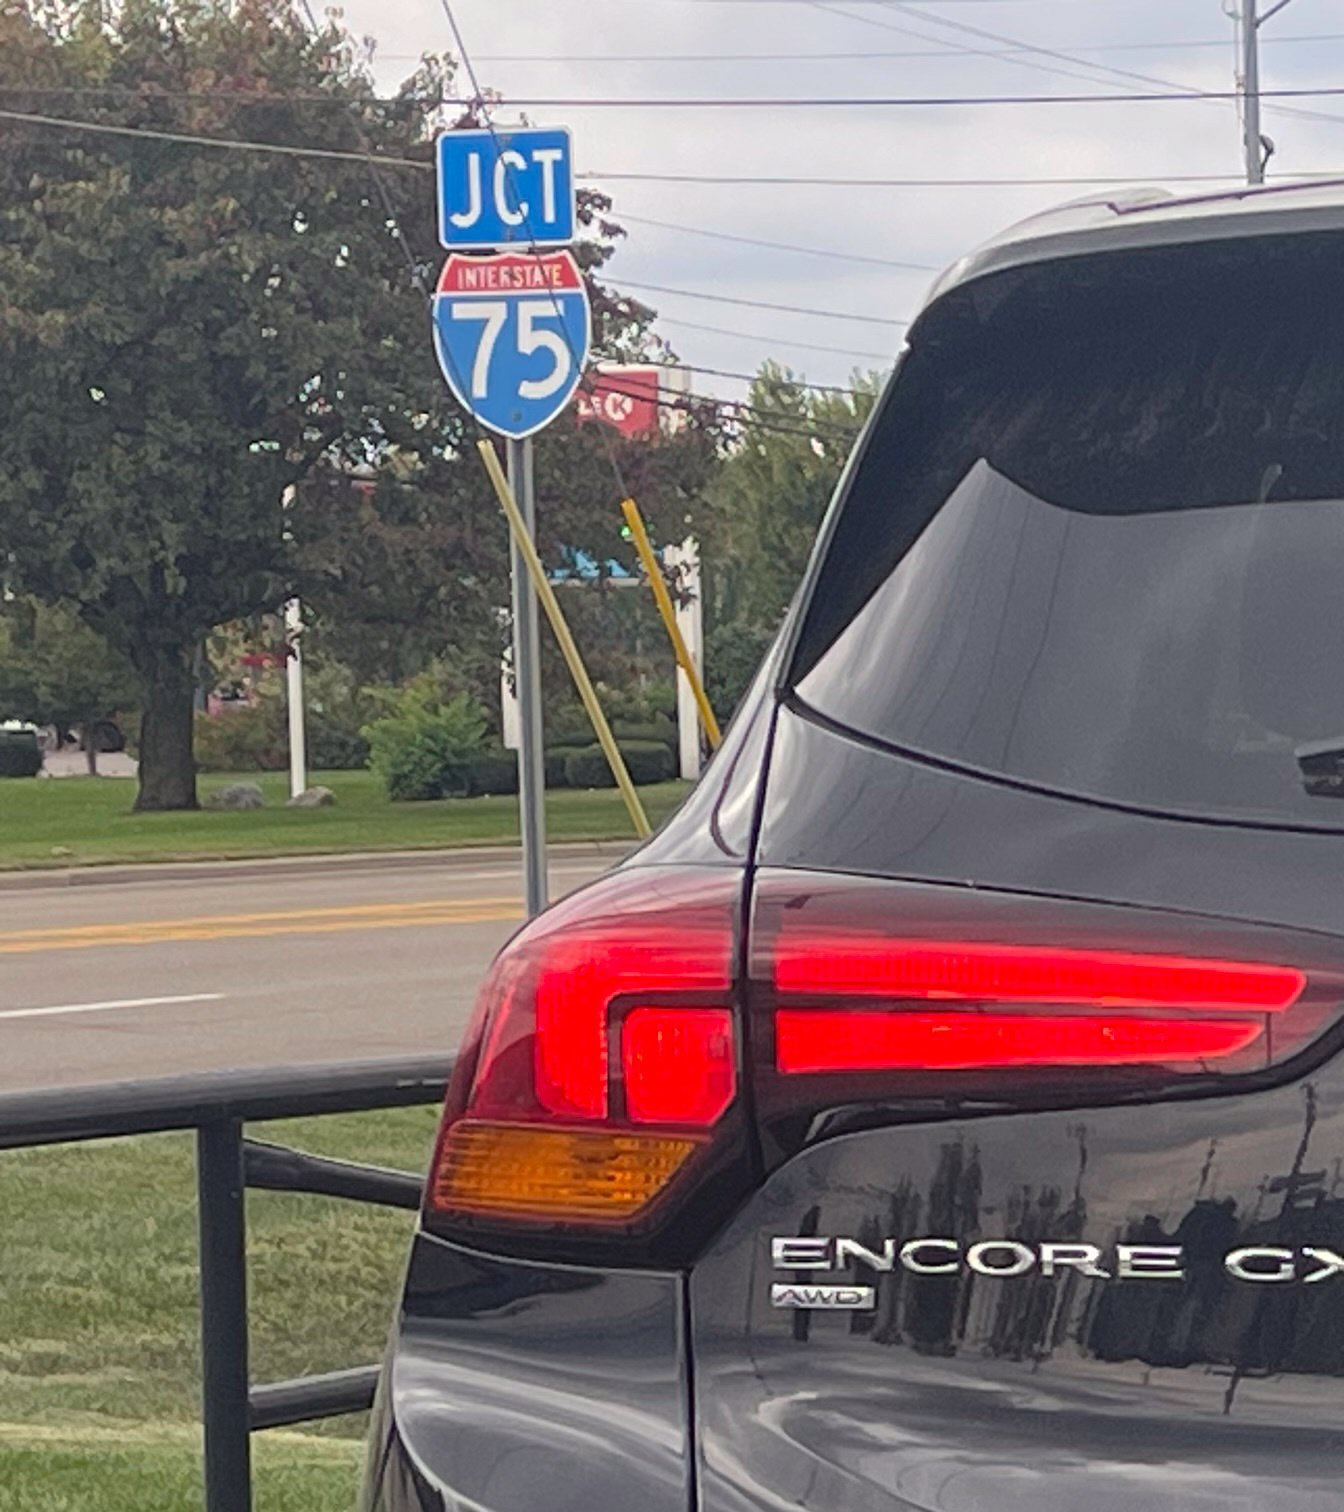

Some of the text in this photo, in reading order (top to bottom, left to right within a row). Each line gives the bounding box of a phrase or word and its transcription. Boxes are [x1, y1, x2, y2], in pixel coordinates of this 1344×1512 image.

[449, 148, 563, 228] JCT
[456, 263, 563, 290] INTERSTATE
[451, 301, 571, 400] 75
[770, 1236, 1185, 1280] ENCORE
[773, 1287, 865, 1306] AWD
